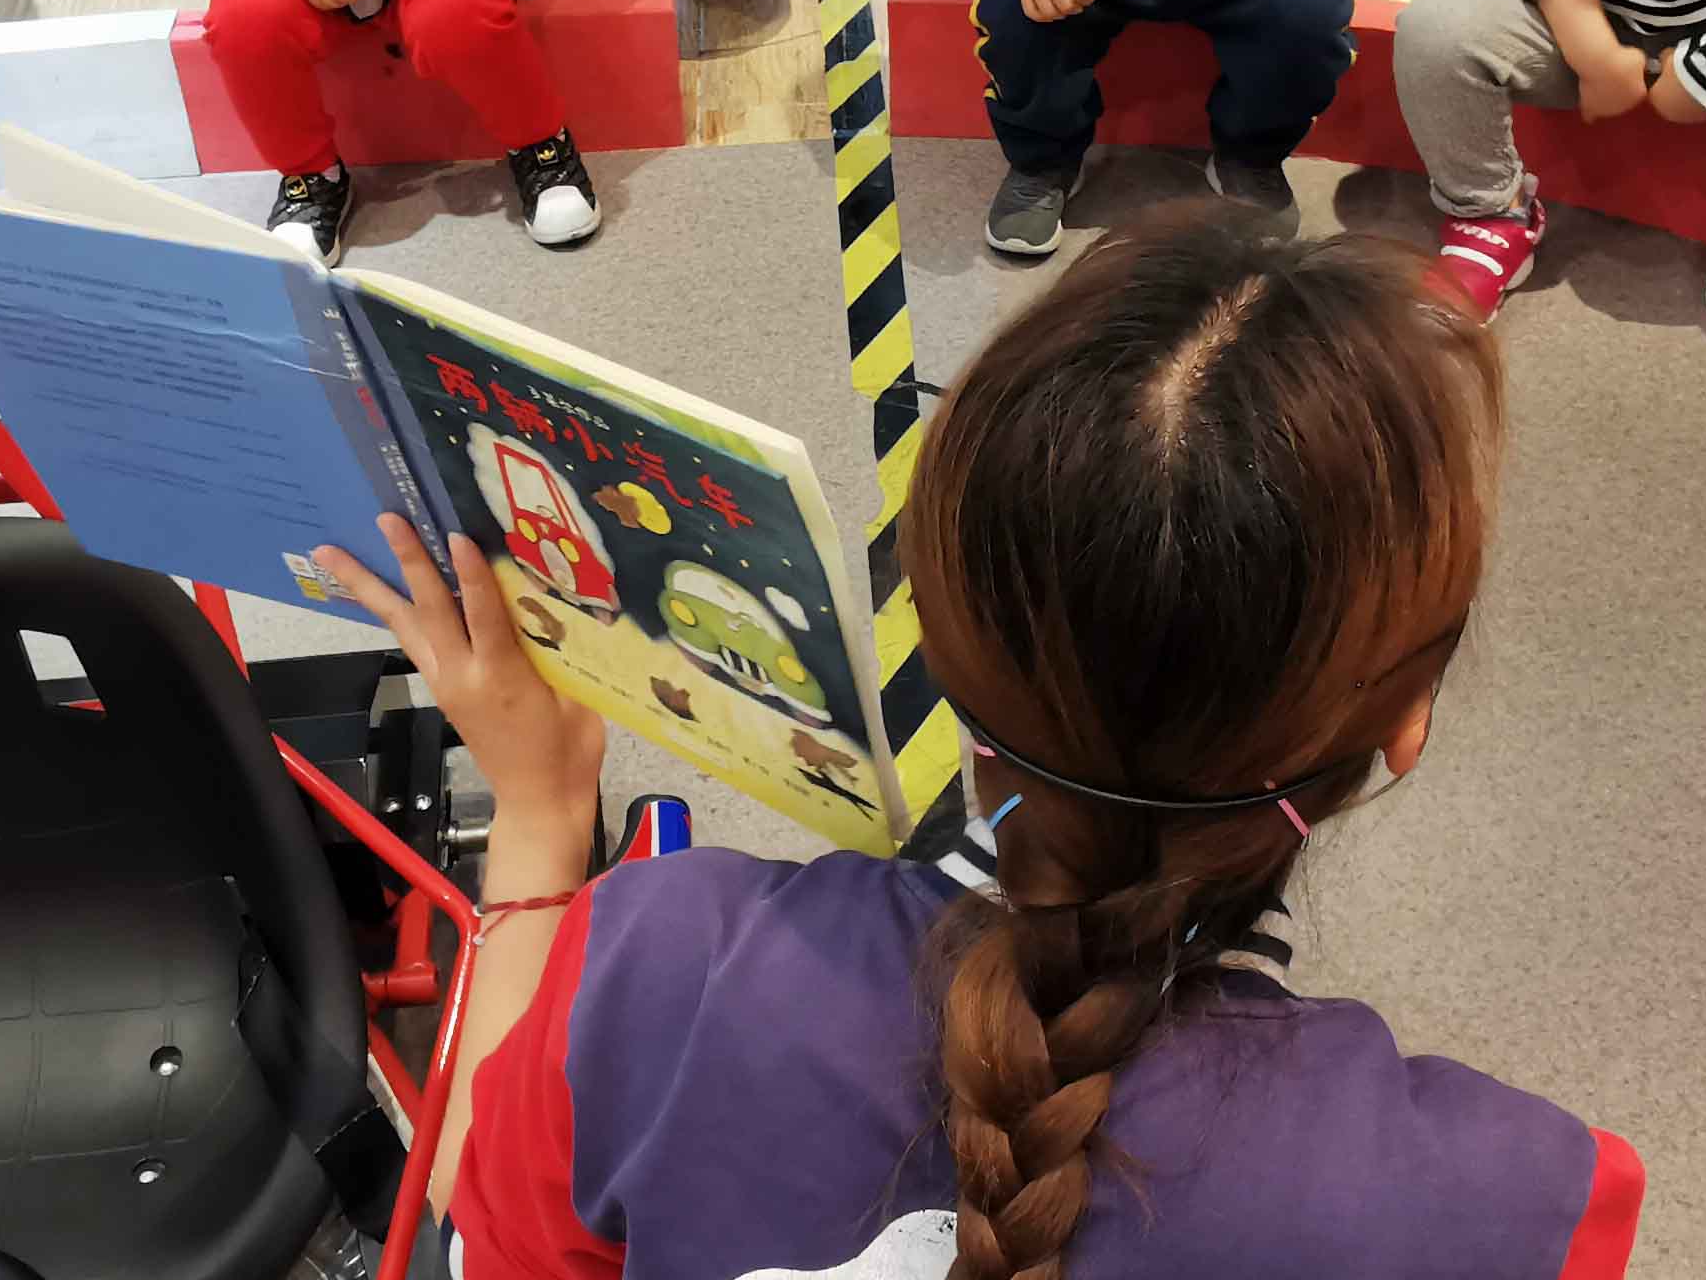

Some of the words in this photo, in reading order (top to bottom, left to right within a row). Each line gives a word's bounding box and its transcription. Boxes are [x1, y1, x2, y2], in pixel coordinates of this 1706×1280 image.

[426, 352, 754, 529] 两辆小汽车
